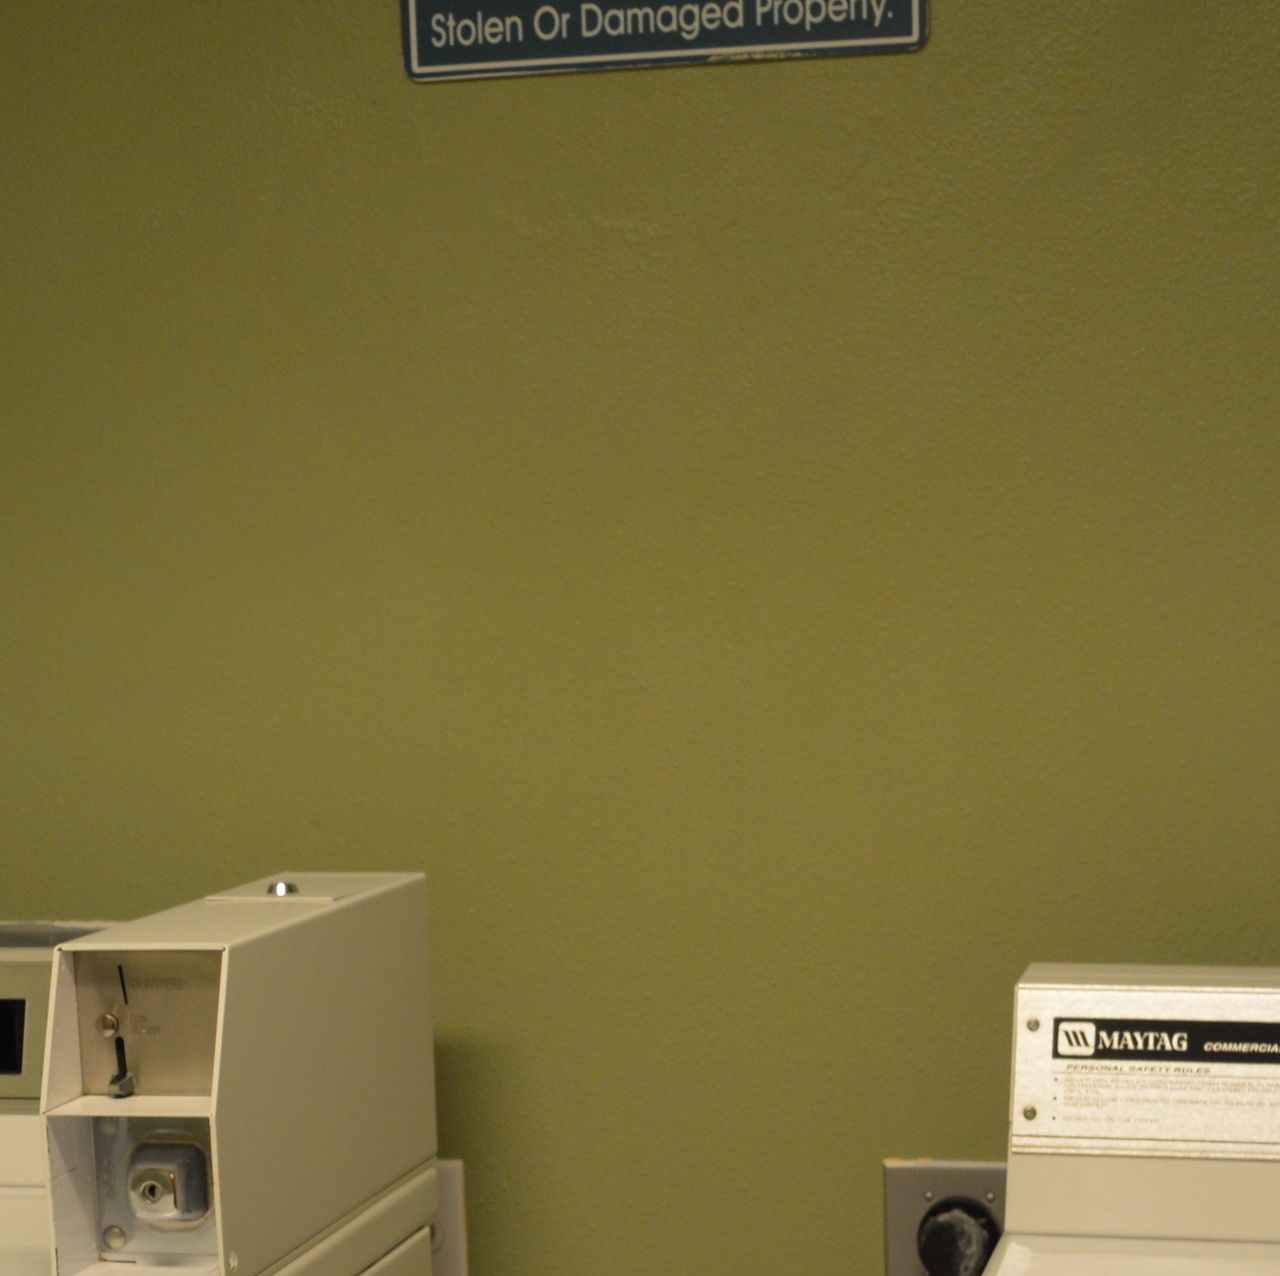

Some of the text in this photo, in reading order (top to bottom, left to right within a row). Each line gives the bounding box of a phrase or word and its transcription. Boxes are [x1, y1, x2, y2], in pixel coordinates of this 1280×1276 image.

[431, 11, 523, 47] Stolen
[534, 5, 570, 40] Or
[581, 0, 744, 40] Damaged
[1097, 1030, 1188, 1052] MAYTAG
[1065, 1063, 1211, 1074] PERSONAL SAFETY RULES
